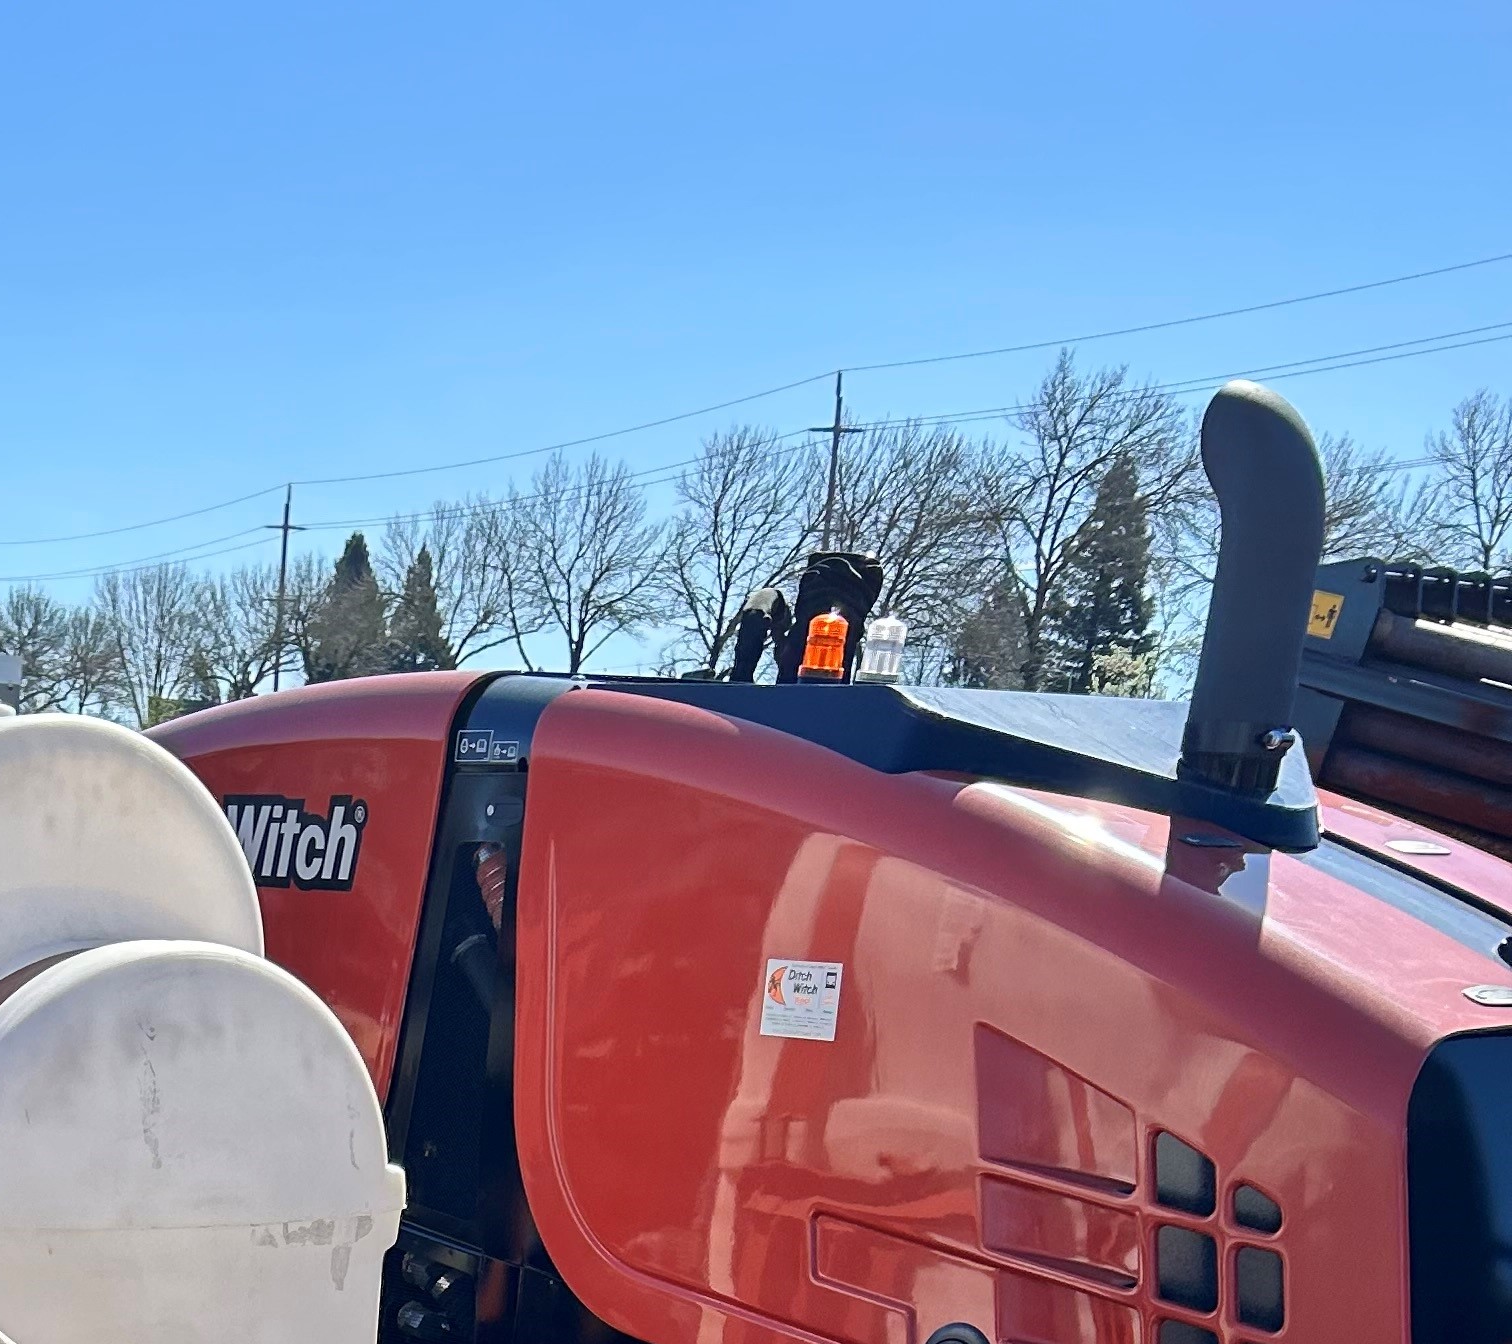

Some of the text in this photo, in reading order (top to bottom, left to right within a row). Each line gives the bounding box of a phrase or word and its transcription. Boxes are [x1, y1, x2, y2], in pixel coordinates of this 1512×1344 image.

[227, 804, 358, 881] Witch
[788, 969, 813, 982] Ditch
[793, 982, 819, 995] Witch
